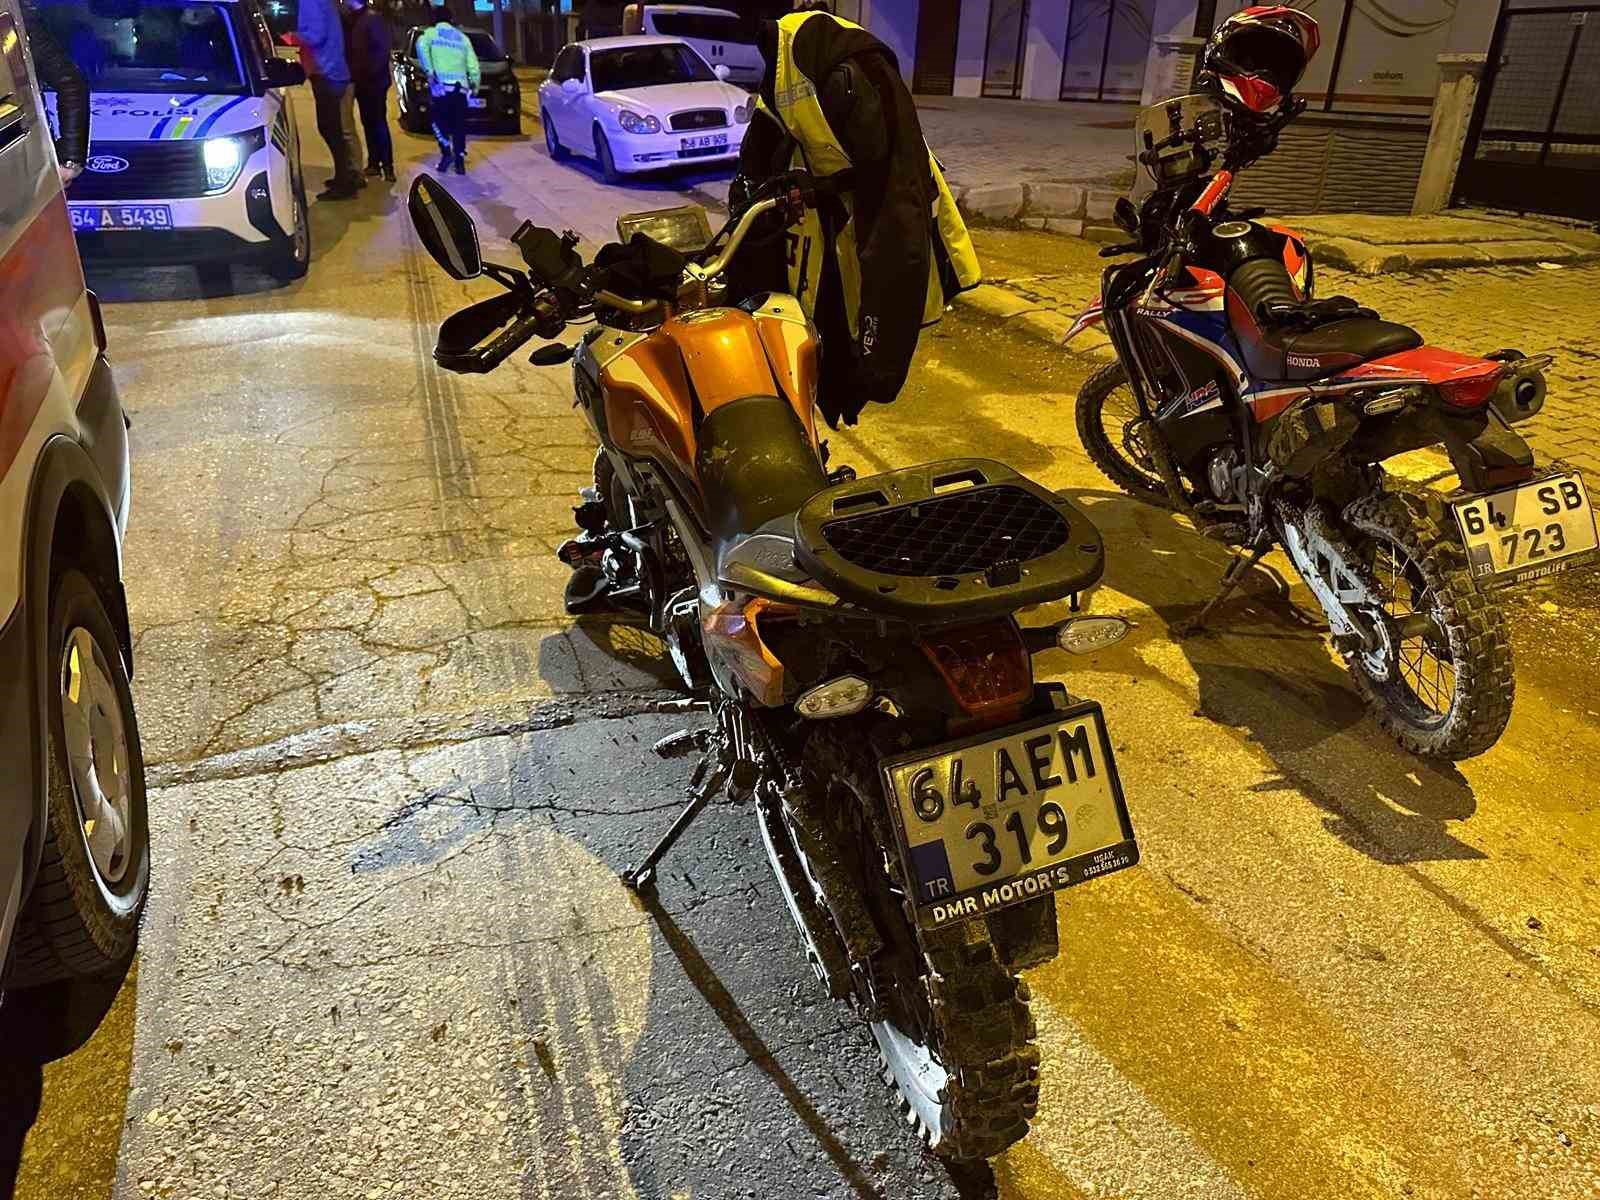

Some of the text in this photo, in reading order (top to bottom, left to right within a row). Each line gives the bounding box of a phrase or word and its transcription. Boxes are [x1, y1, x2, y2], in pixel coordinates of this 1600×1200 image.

[91, 158, 120, 170] Ford
[71, 208, 167, 226] 64 A 5439
[1136, 308, 1170, 318] RALLY
[1286, 356, 1321, 368] HONDA
[1463, 481, 1583, 535] 64 SB
[1501, 523, 1566, 565] 723
[1477, 562, 1494, 577] TR
[911, 724, 1096, 823] 64 AEM
[965, 801, 1069, 876] 319
[926, 877, 950, 898] TR
[932, 866, 1070, 923] DMR MOTOR'S
